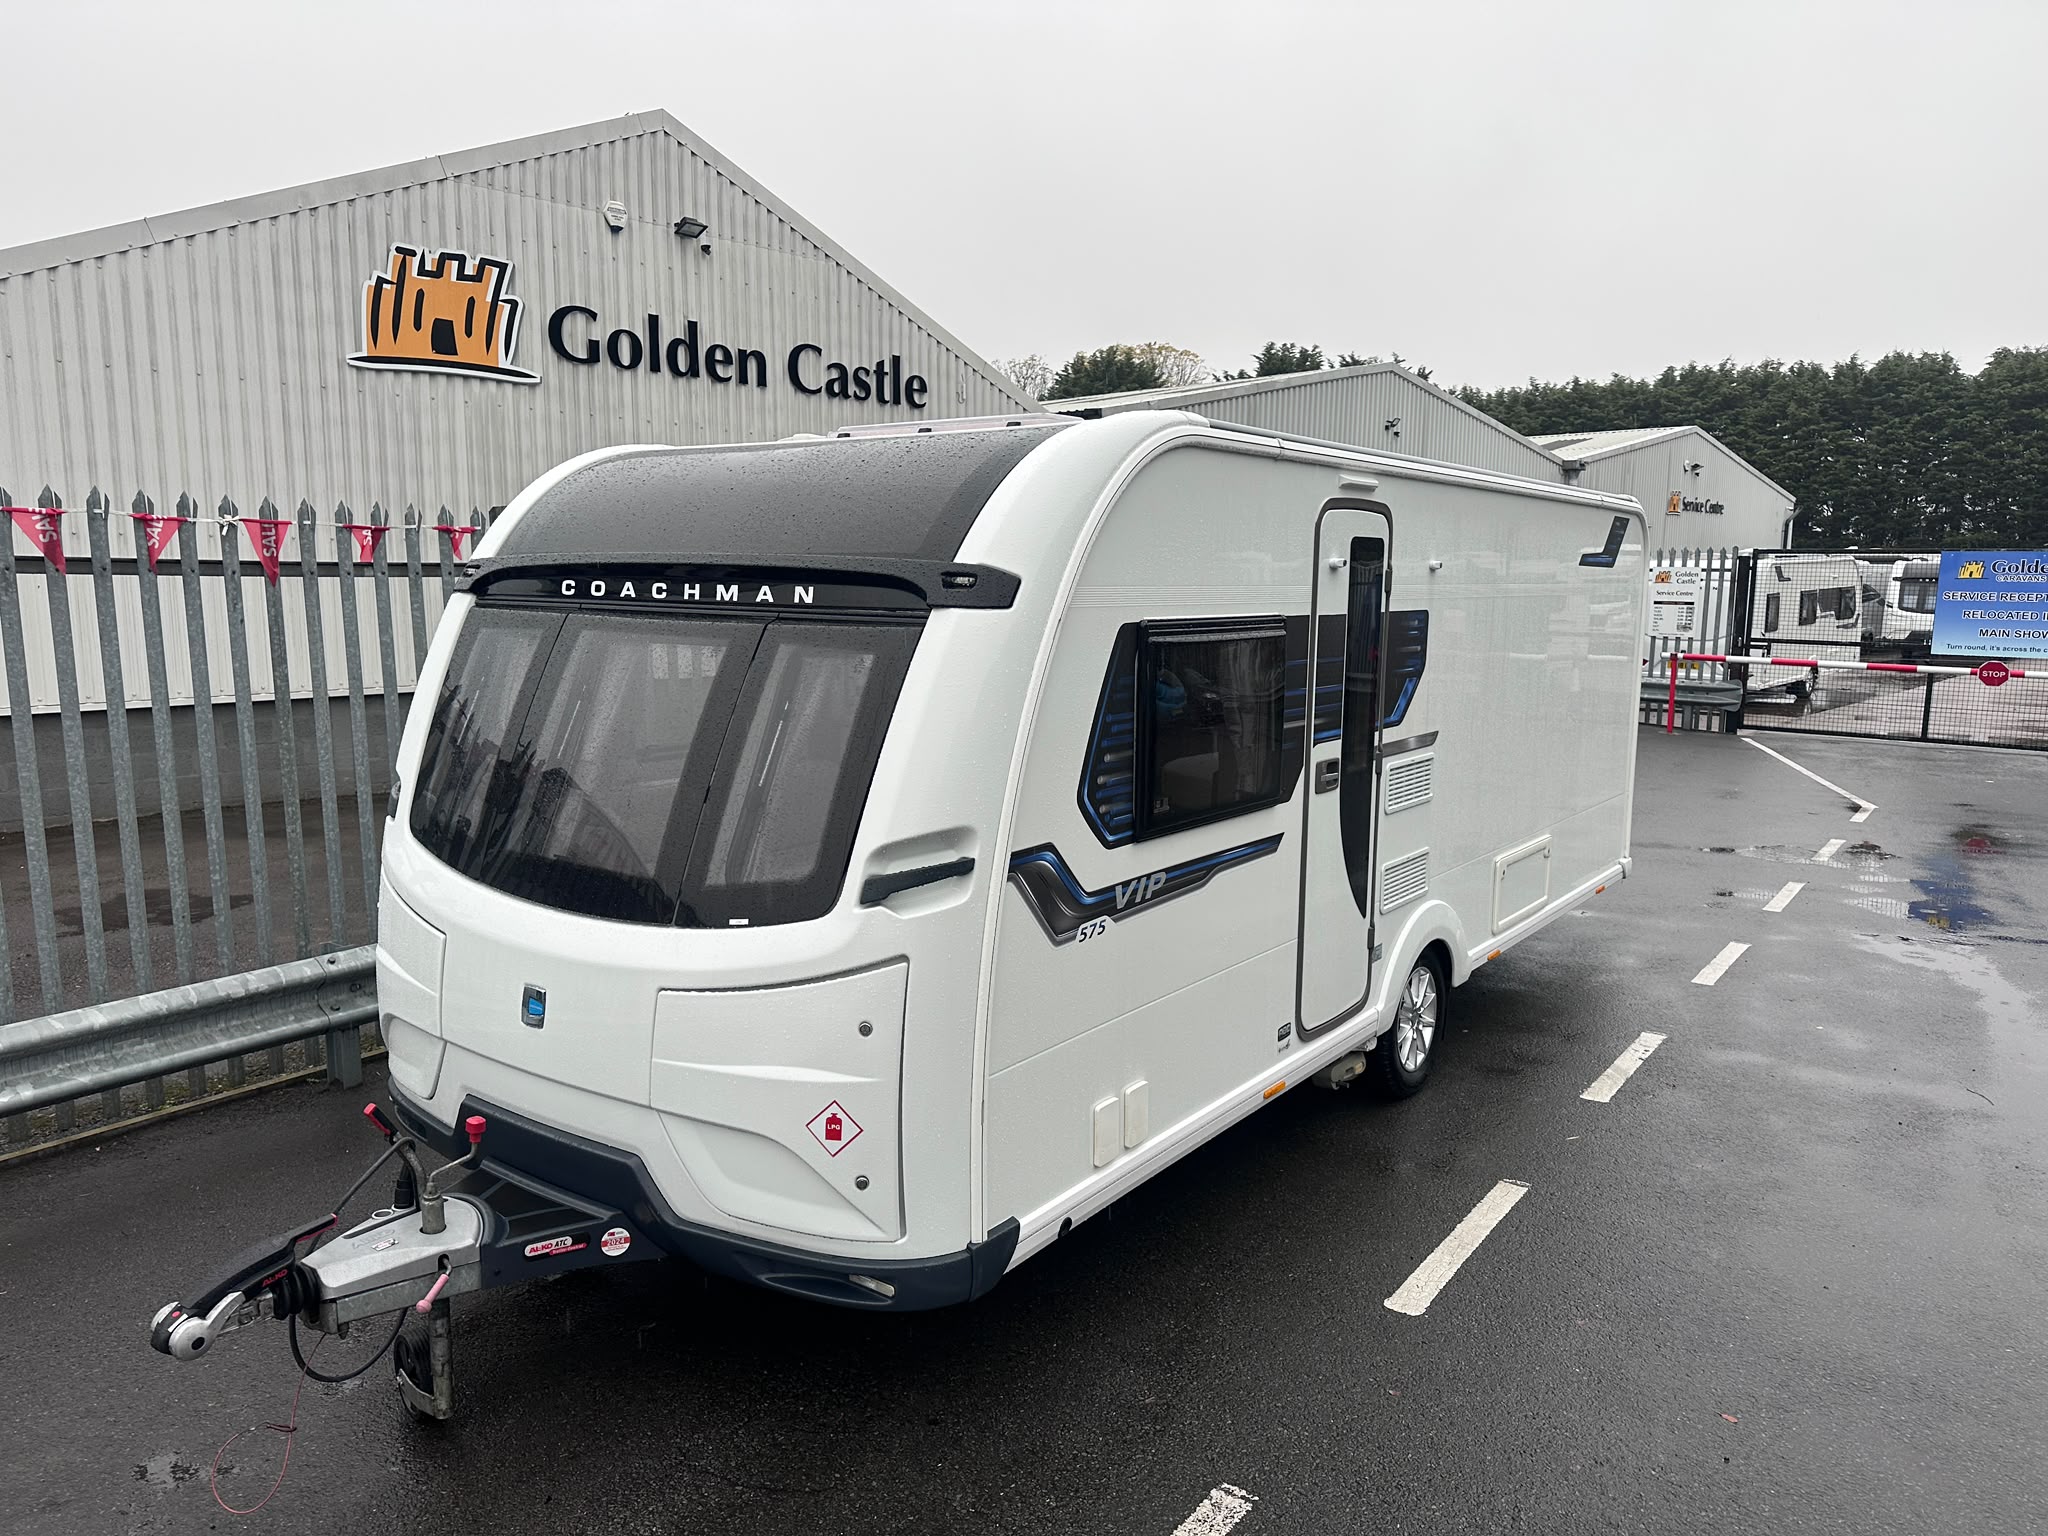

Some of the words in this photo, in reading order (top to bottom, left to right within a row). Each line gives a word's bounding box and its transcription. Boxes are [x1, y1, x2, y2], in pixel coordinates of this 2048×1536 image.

[548, 304, 768, 388] Golden
[787, 342, 929, 409] Castle
[1682, 496, 1704, 513] Service
[1705, 499, 1725, 515] Centre
[1675, 570, 1699, 578] Golden
[1995, 574, 2047, 583] CARAVANS
[1676, 577, 1697, 585] Castle
[560, 578, 814, 604] COACHMAN
[1943, 591, 1997, 601] SERVICE
[1962, 610, 2039, 620] RELOCATED
[1978, 628, 2011, 638] MAIN
[1964, 644, 1988, 652] round,
[1981, 670, 2006, 678] STOP
[1114, 871, 1167, 910] VIP
[1078, 919, 1107, 943] 575
[554, 1238, 569, 1249] ATC
